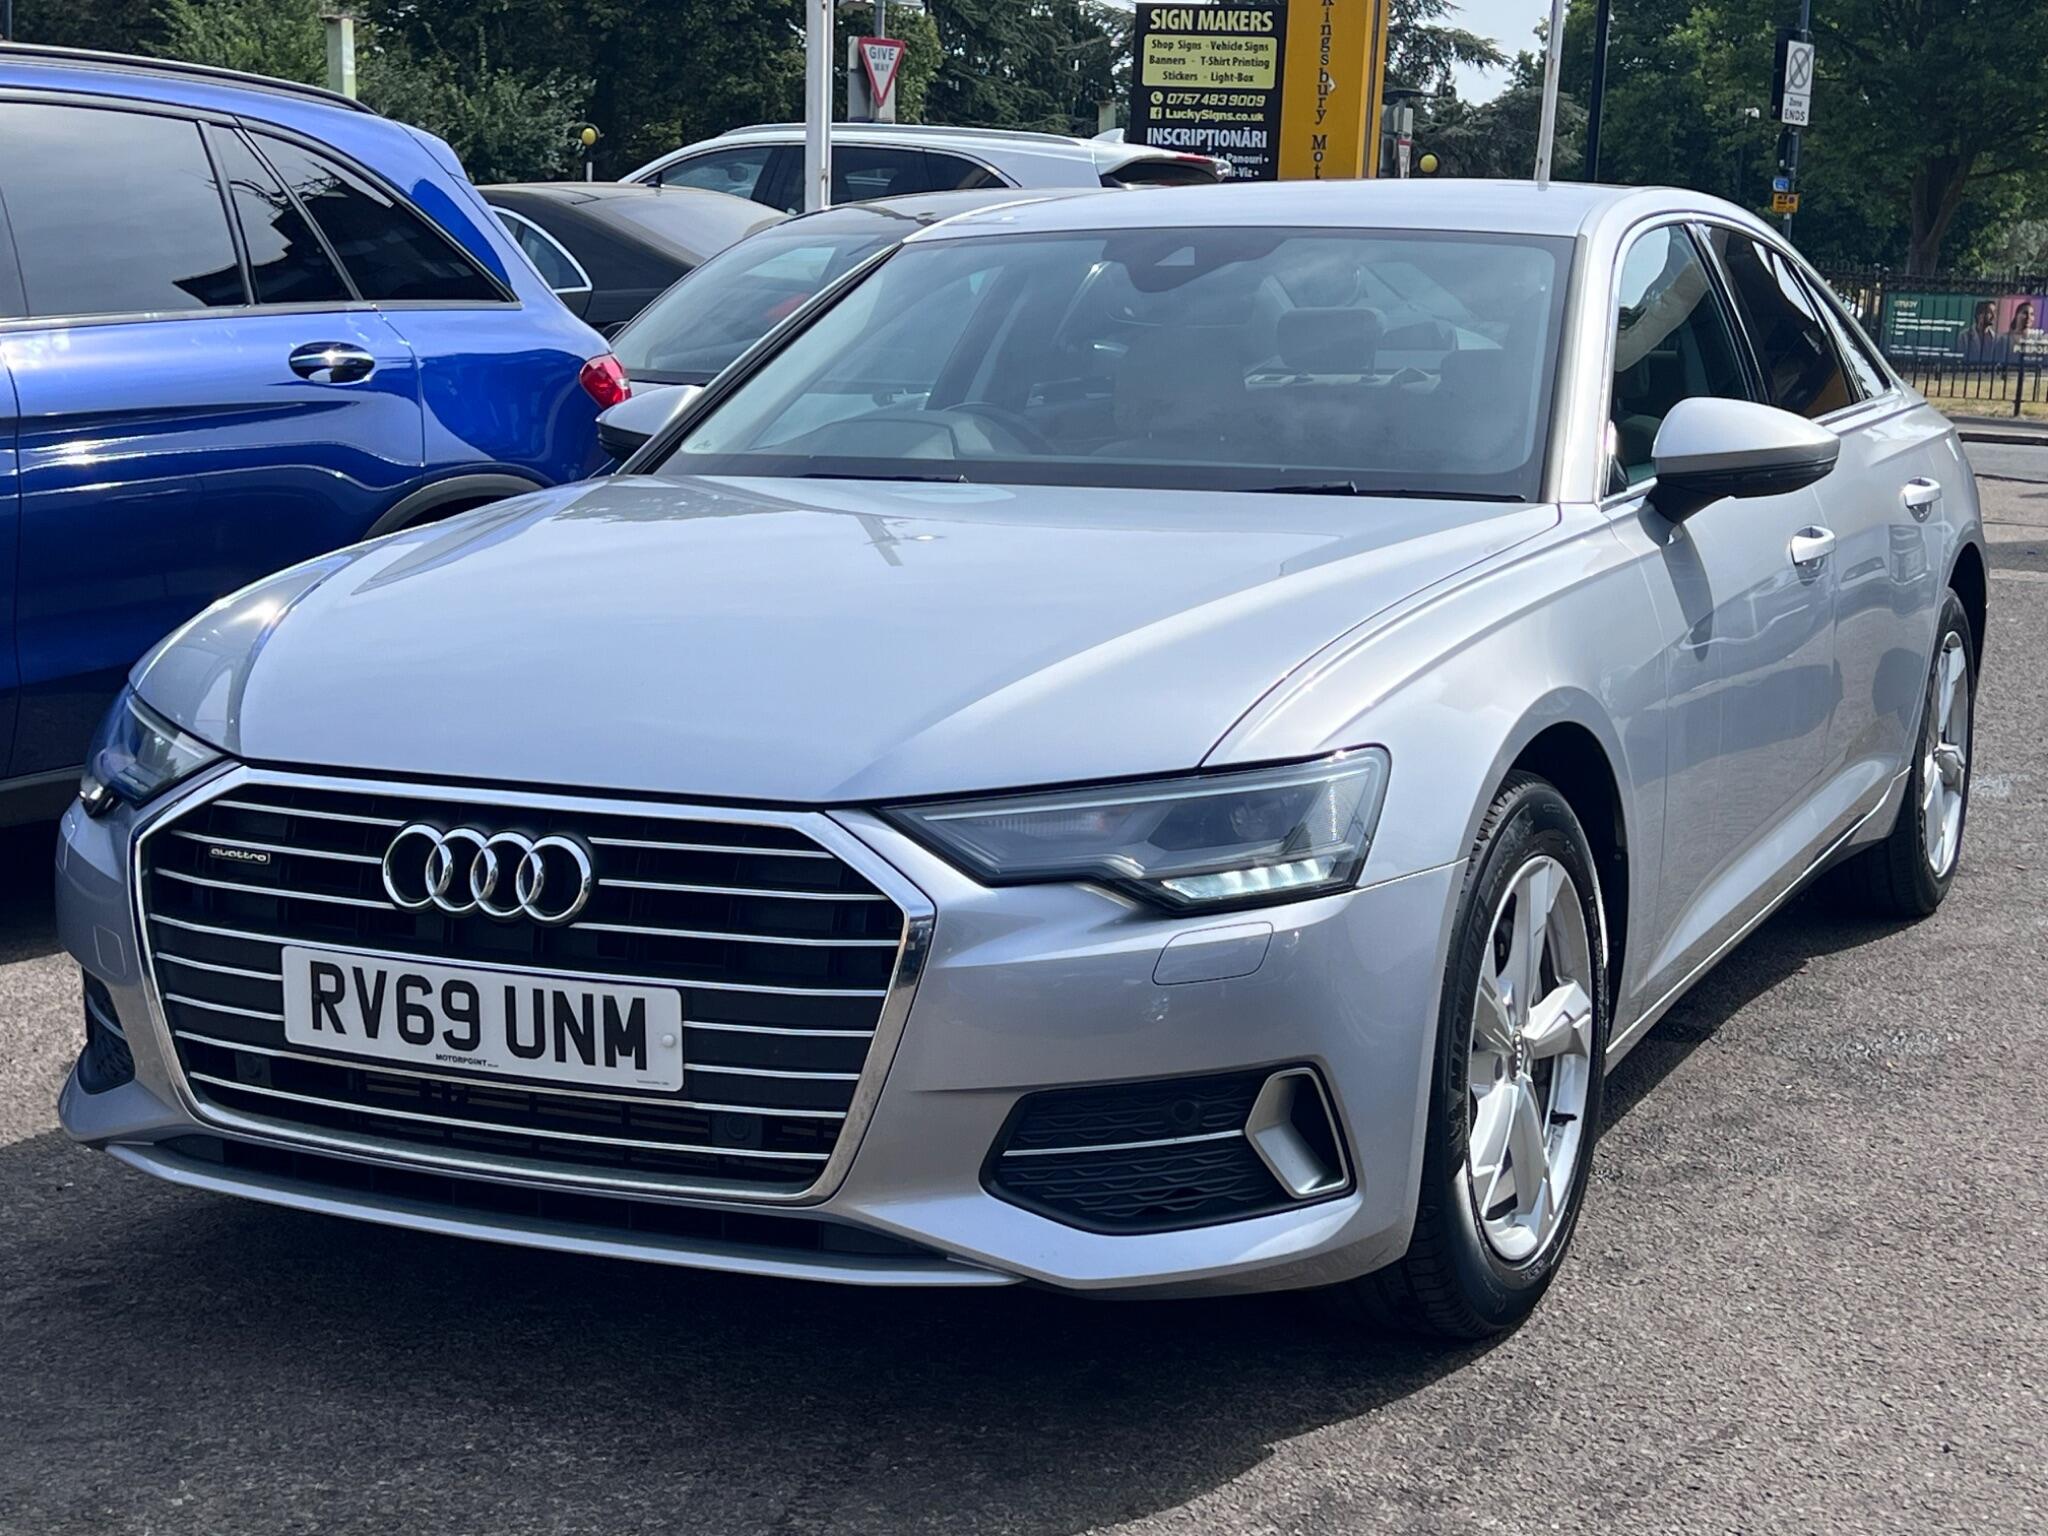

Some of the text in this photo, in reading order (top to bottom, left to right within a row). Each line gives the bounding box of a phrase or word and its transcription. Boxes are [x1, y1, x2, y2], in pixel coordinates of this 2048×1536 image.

[1150, 9, 1274, 32] SIGN MAKERS
[869, 46, 895, 60] GIVE
[1151, 40, 1269, 53] Shop Signs Vehicle Signs
[1149, 55, 1270, 69] Banners T-Shirt Printing
[1162, 71, 1254, 83] Stickers Light-Box
[1165, 108, 1265, 123] LuckySigns.co.uk
[1784, 109, 1805, 121] ENDS
[1226, 153, 1263, 164] Panouri
[210, 847, 267, 861] quattro
[309, 960, 648, 1071] RV69 UNM
[435, 1053, 487, 1067] MOTORPOINT
